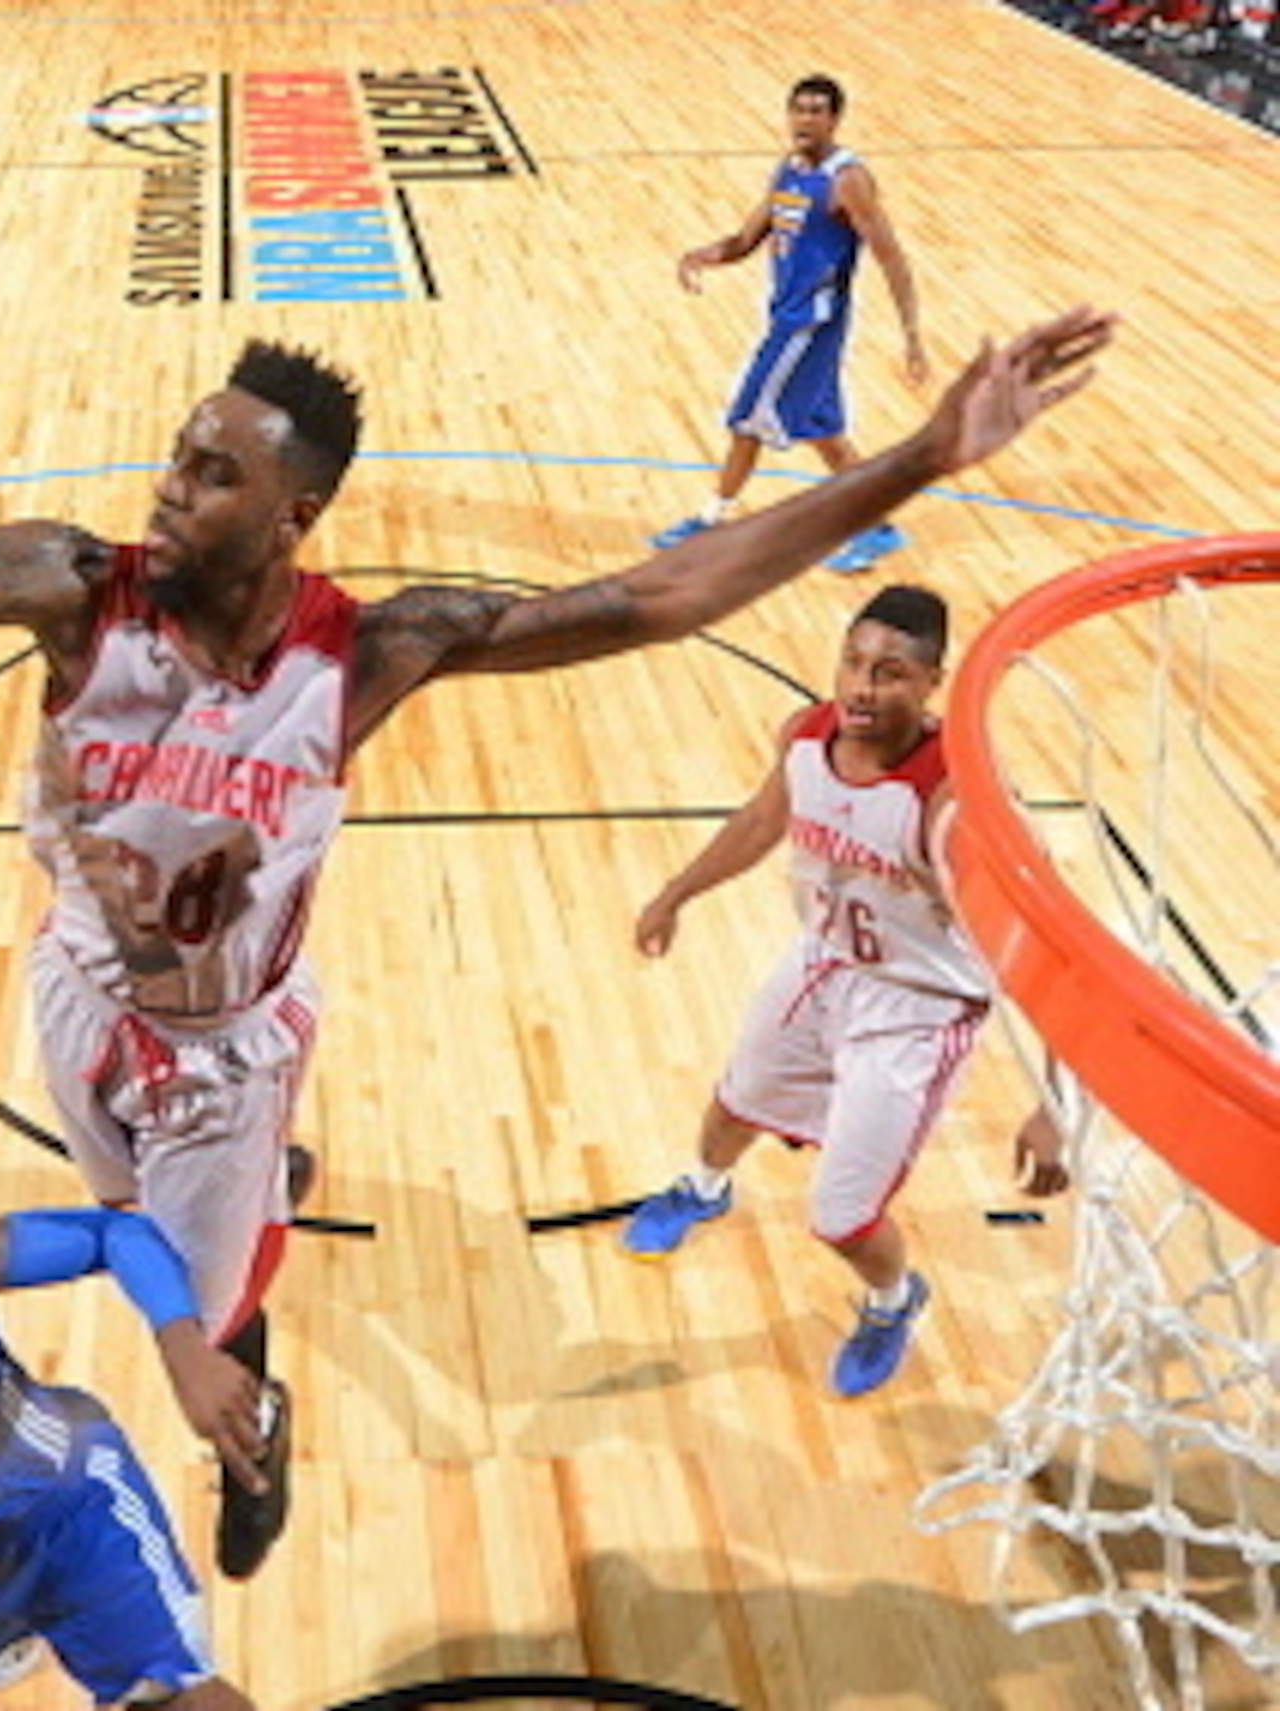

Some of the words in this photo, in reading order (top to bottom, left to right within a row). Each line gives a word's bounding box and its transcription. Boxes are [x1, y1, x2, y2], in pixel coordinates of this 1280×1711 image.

[241, 72, 385, 208] SUMMER
[357, 66, 516, 181] LEAGUE
[249, 208, 407, 303] NBA
